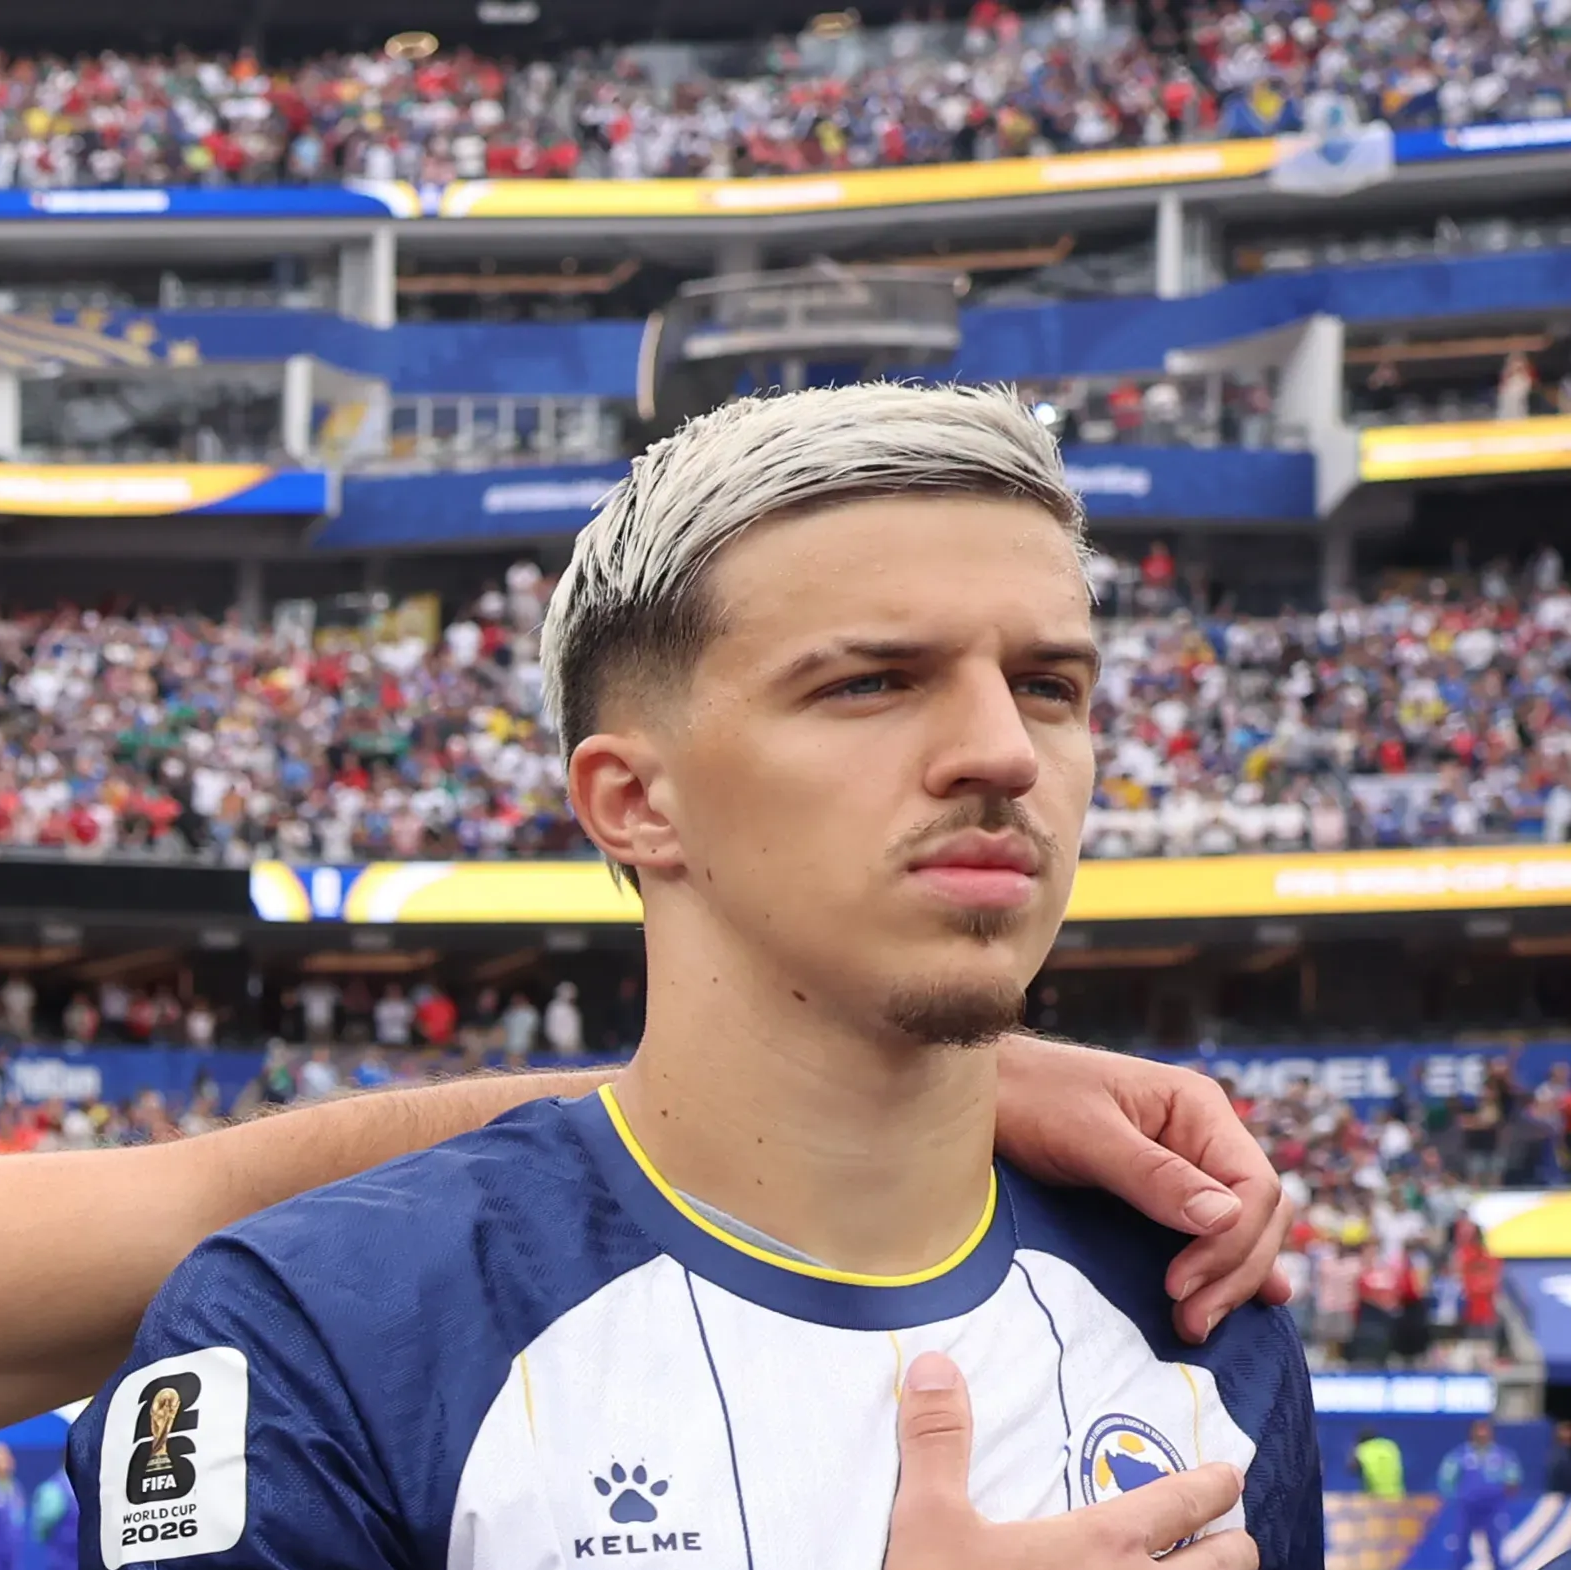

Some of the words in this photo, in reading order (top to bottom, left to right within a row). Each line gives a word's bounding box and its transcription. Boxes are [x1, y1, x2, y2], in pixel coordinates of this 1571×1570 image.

[142, 1474, 177, 1493] FIFA
[123, 1509, 168, 1525] WORLD
[171, 1503, 197, 1518] CUP
[121, 1518, 198, 1547] 2026
[574, 1532, 702, 1558] KELME
